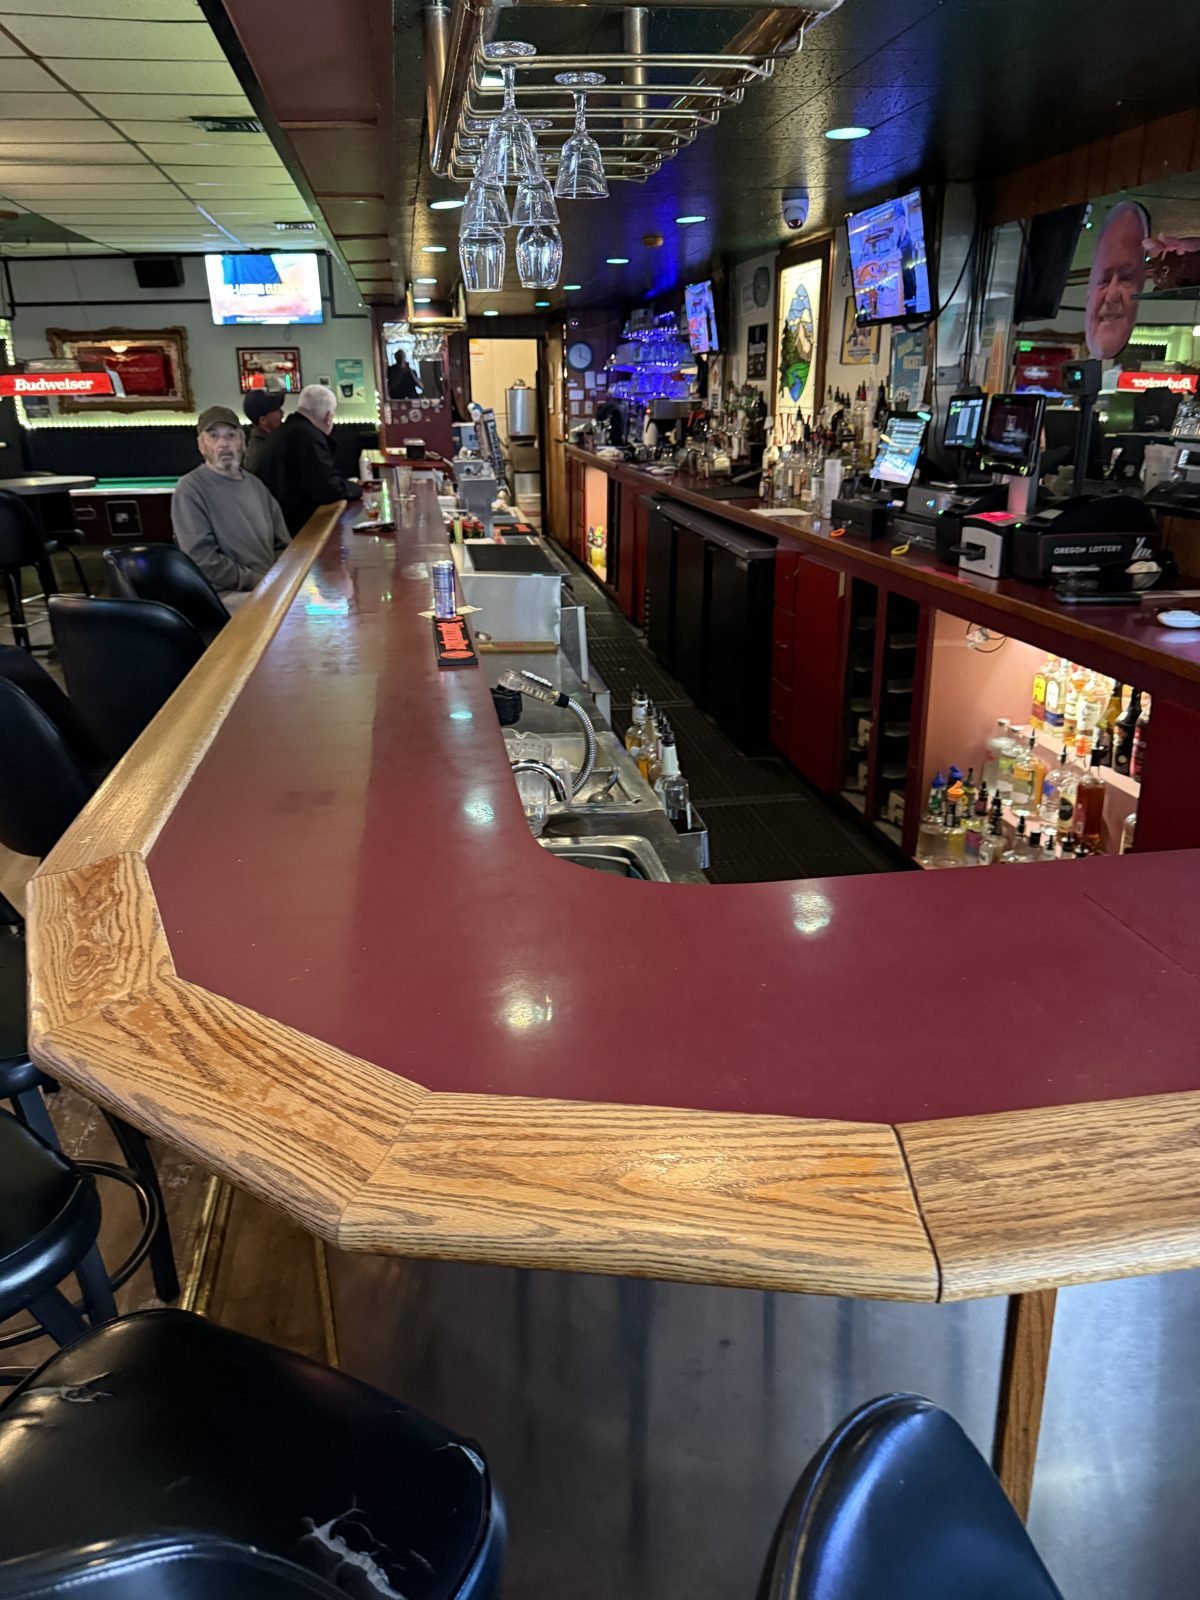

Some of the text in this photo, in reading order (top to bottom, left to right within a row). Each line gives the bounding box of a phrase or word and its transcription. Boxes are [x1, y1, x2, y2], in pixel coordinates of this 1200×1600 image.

[14, 378, 94, 391] Budweiser
[1053, 545, 1122, 554] OREGON LOTTERY
